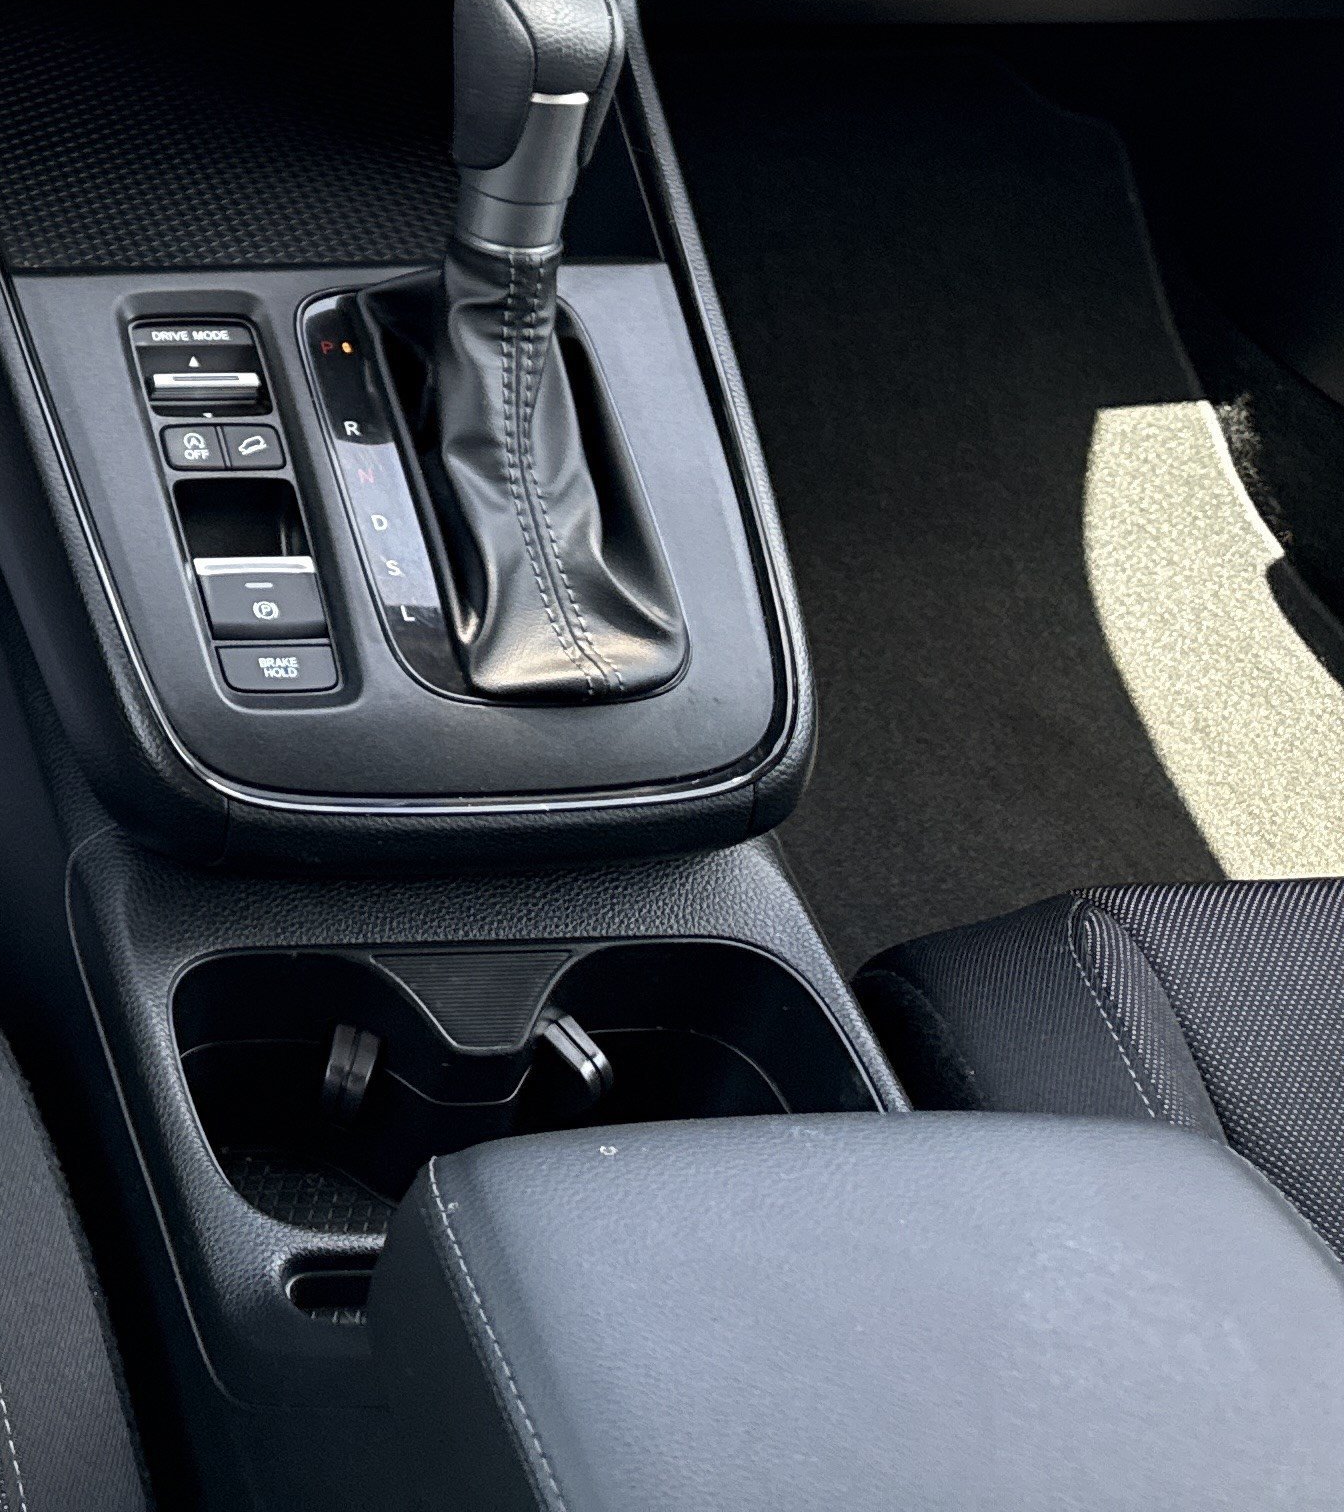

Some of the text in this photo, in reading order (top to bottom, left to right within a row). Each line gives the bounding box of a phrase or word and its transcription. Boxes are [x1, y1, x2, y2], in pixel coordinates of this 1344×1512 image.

[151, 330, 230, 342] DRIVE MODE
[321, 341, 333, 355] P
[344, 420, 361, 436] R
[184, 448, 209, 460] OFF
[357, 468, 374, 484] N
[371, 514, 388, 531] D
[385, 560, 401, 576] S
[402, 605, 415, 622] L
[258, 657, 298, 669] BRAKE
[263, 666, 298, 678] HOLD
